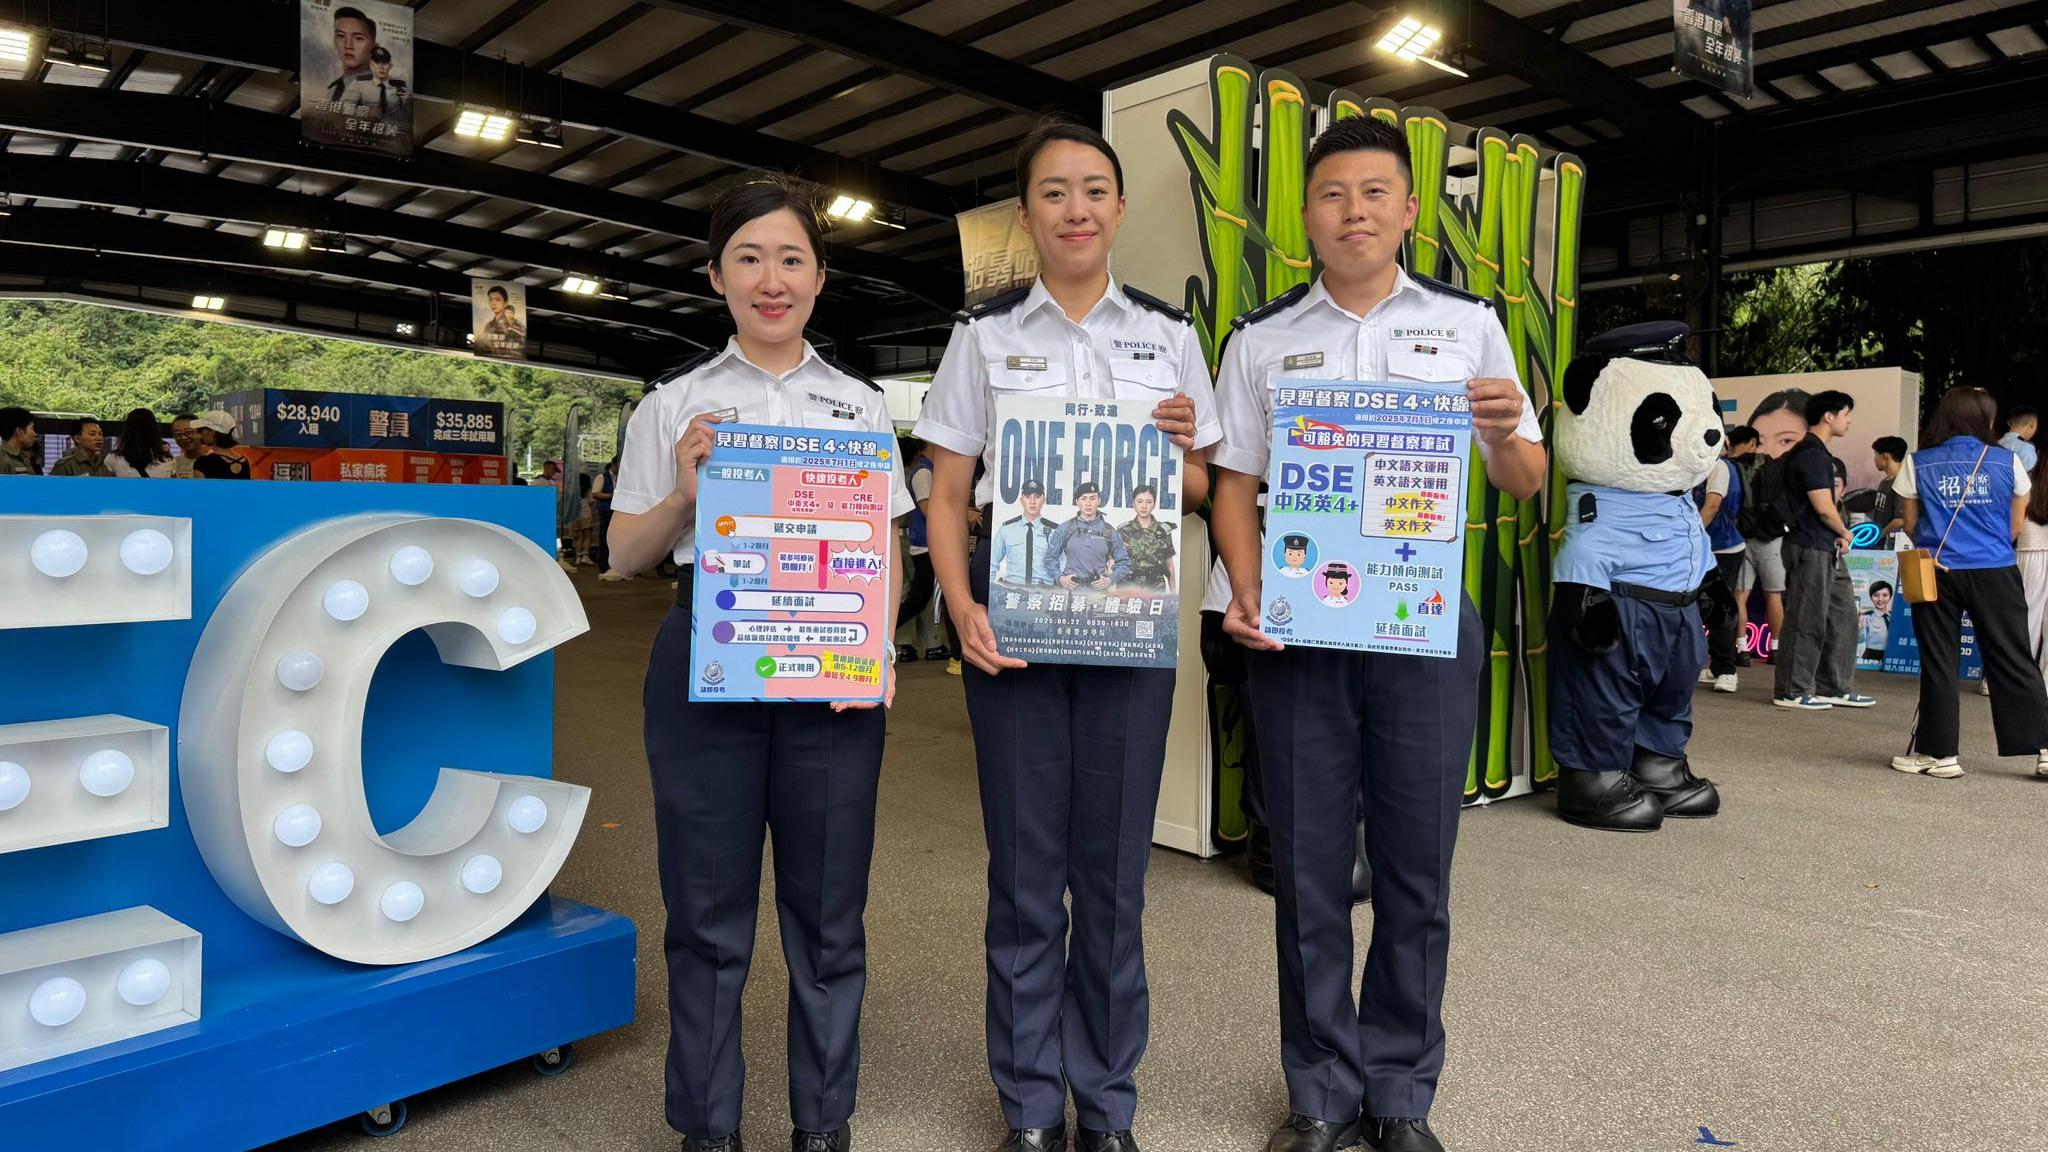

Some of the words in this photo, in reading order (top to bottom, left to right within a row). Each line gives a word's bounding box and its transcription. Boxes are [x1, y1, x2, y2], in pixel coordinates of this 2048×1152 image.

[1406, 329, 1444, 337] POLICE
[1124, 341, 1157, 350] POLICE
[820, 396, 854, 411] POLICE
[1279, 388, 1350, 408] 見習督察
[1354, 392, 1399, 410] DSE
[277, 402, 340, 422] $28,940
[369, 410, 410, 438] 警員
[436, 411, 493, 430] $35,885
[433, 429, 496, 443] 完成三年試用期
[716, 431, 779, 450] 見習督察
[782, 436, 819, 452] DSE
[1303, 430, 1451, 452] 可豁免的見習督察筆試
[339, 463, 387, 478] 私家病床
[1000, 418, 1065, 505] ONE
[1072, 422, 1176, 510] FORCE
[1374, 458, 1449, 474] 中文語文運用
[709, 468, 766, 481] 一般投考人
[805, 474, 859, 487] 快線投考人
[1279, 462, 1354, 493] DSE
[1373, 475, 1447, 490] 英文語文運用
[794, 490, 814, 499] DSE
[853, 493, 873, 502] CRE
[1274, 492, 1359, 513] 中及英4+
[1385, 497, 1434, 510] 中文作文
[774, 523, 817, 535] 遞交申請
[1384, 519, 1433, 533] 英文作文
[733, 560, 751, 568] 筆試
[1366, 563, 1444, 580] 能力傾向測試
[1389, 582, 1418, 592] PASS
[771, 595, 815, 607] 延續面試
[1417, 602, 1443, 616] 直達
[1376, 622, 1427, 637] 延續面試
[778, 662, 815, 672] 正式聘用
